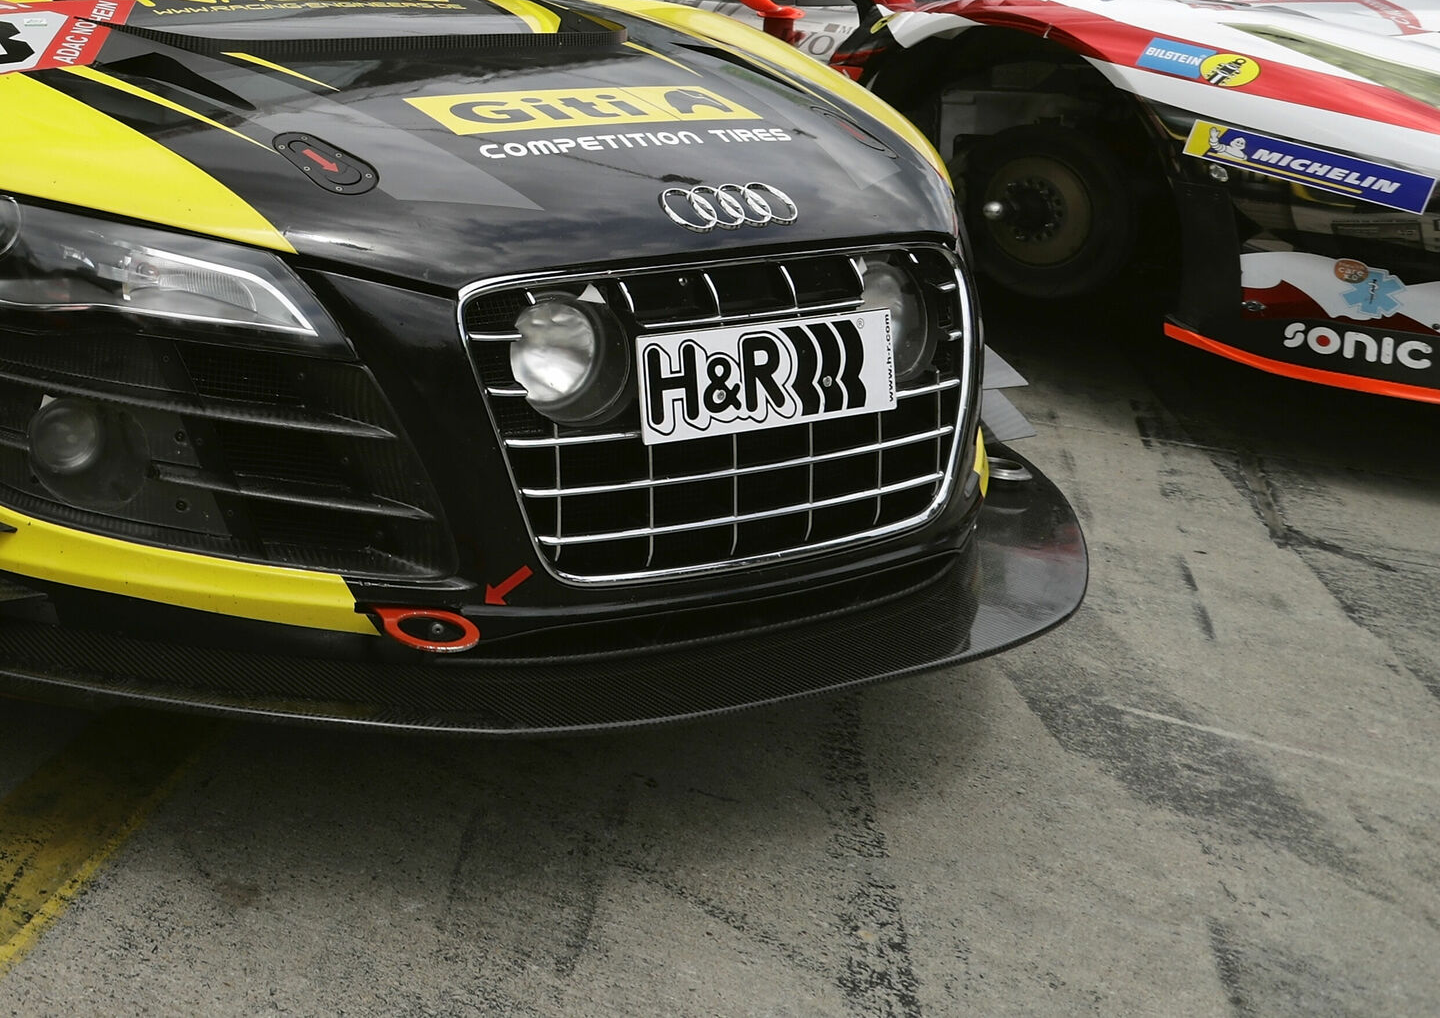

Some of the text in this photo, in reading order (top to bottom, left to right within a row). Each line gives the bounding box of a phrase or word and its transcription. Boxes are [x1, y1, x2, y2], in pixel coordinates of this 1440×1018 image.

[52, 31, 88, 65] ADAC
[1145, 46, 1203, 67] BILSTEIN
[450, 93, 650, 124] Giti
[480, 128, 792, 159] COMPETITION TIRES
[1251, 148, 1402, 194] MICHELIN
[885, 313, 894, 403] www.h-r.com
[643, 330, 797, 436] H&R
